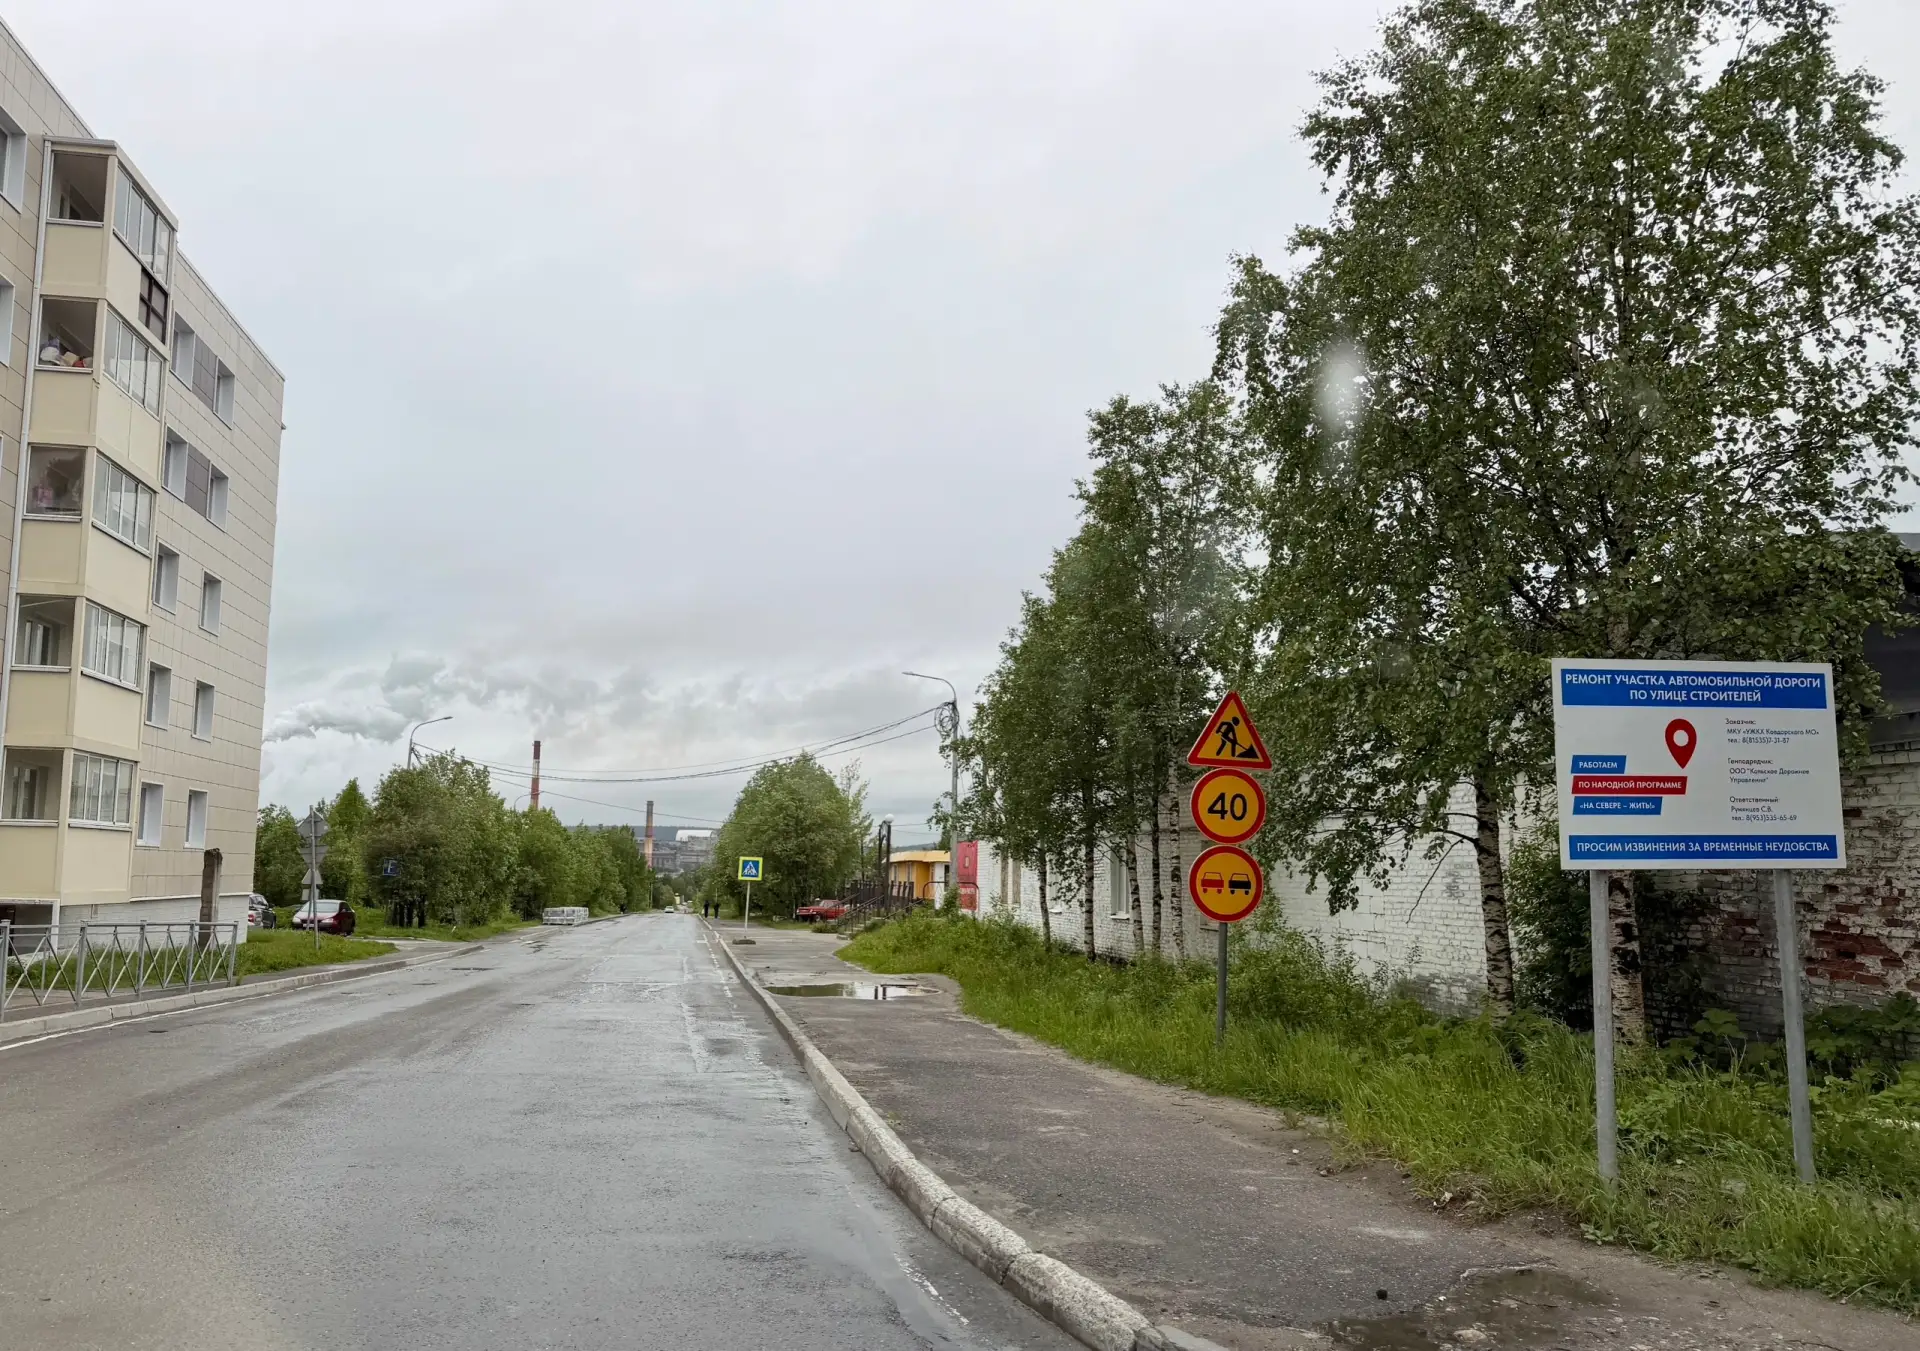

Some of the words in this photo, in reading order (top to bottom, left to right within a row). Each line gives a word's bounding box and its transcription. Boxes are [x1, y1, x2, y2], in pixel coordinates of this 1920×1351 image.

[1566, 674, 1611, 685] РЕМОНТ
[1615, 675, 1665, 686] УЧАСТКА
[1668, 674, 1772, 687] АВТОМОБИЛЬНОЙ
[1774, 678, 1820, 689] ДОРОГИ
[1630, 690, 1647, 700] ПО
[1650, 691, 1687, 702] УЛИЦЕ
[1690, 690, 1761, 702] СТРОИТЕЛЕЙ
[1592, 780, 1634, 789] НАРОДНОЙ
[1208, 792, 1247, 821] 40
[1577, 843, 1622, 852] ПРОСИМ
[1625, 843, 1685, 852] ИЗВИНЕНИЯ
[1689, 842, 1701, 851] ЗА
[1704, 842, 1763, 852] ВРЕМЕННЫЕ
[1765, 842, 1829, 852] НЕУДОБСТВА
